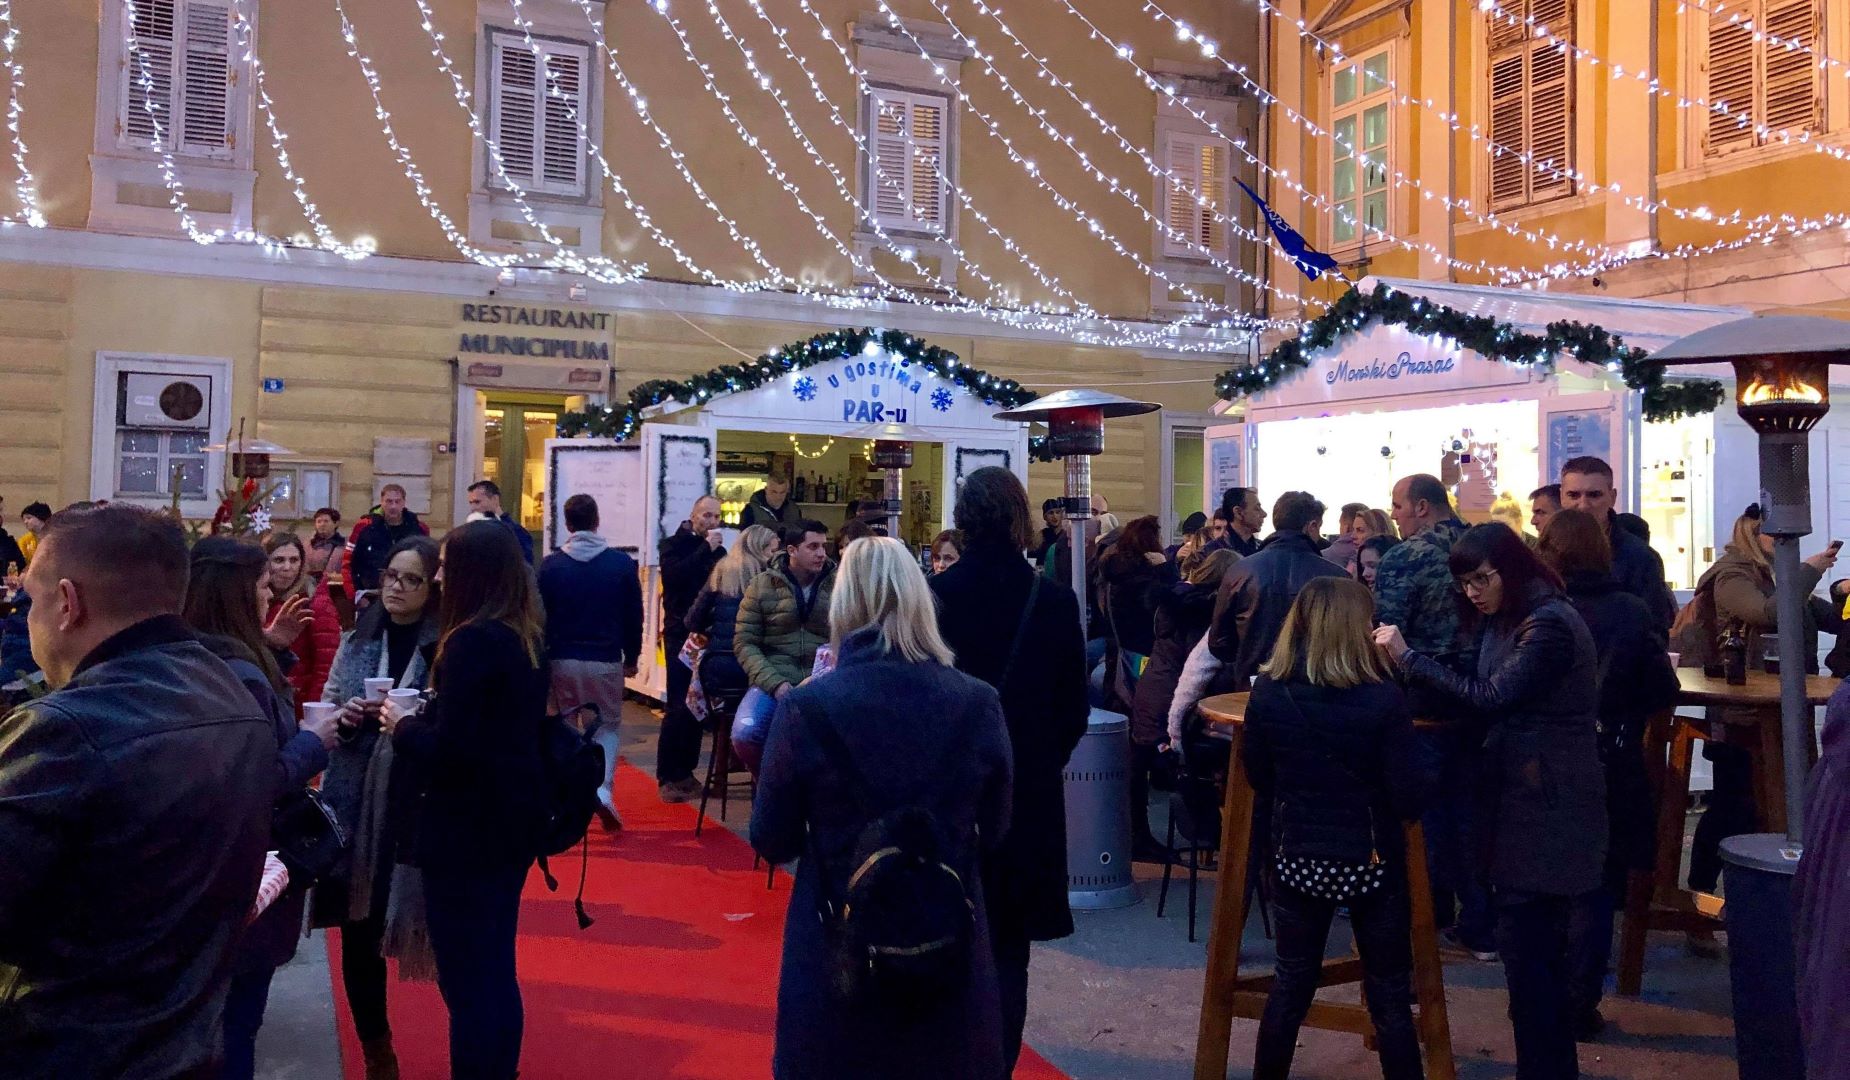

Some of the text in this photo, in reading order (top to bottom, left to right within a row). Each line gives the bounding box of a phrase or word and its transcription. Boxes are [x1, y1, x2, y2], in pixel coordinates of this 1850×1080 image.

[463, 304, 610, 330] RESTAURANT
[460, 333, 609, 360] MUNICIPIUM
[844, 361, 922, 394] gostima
